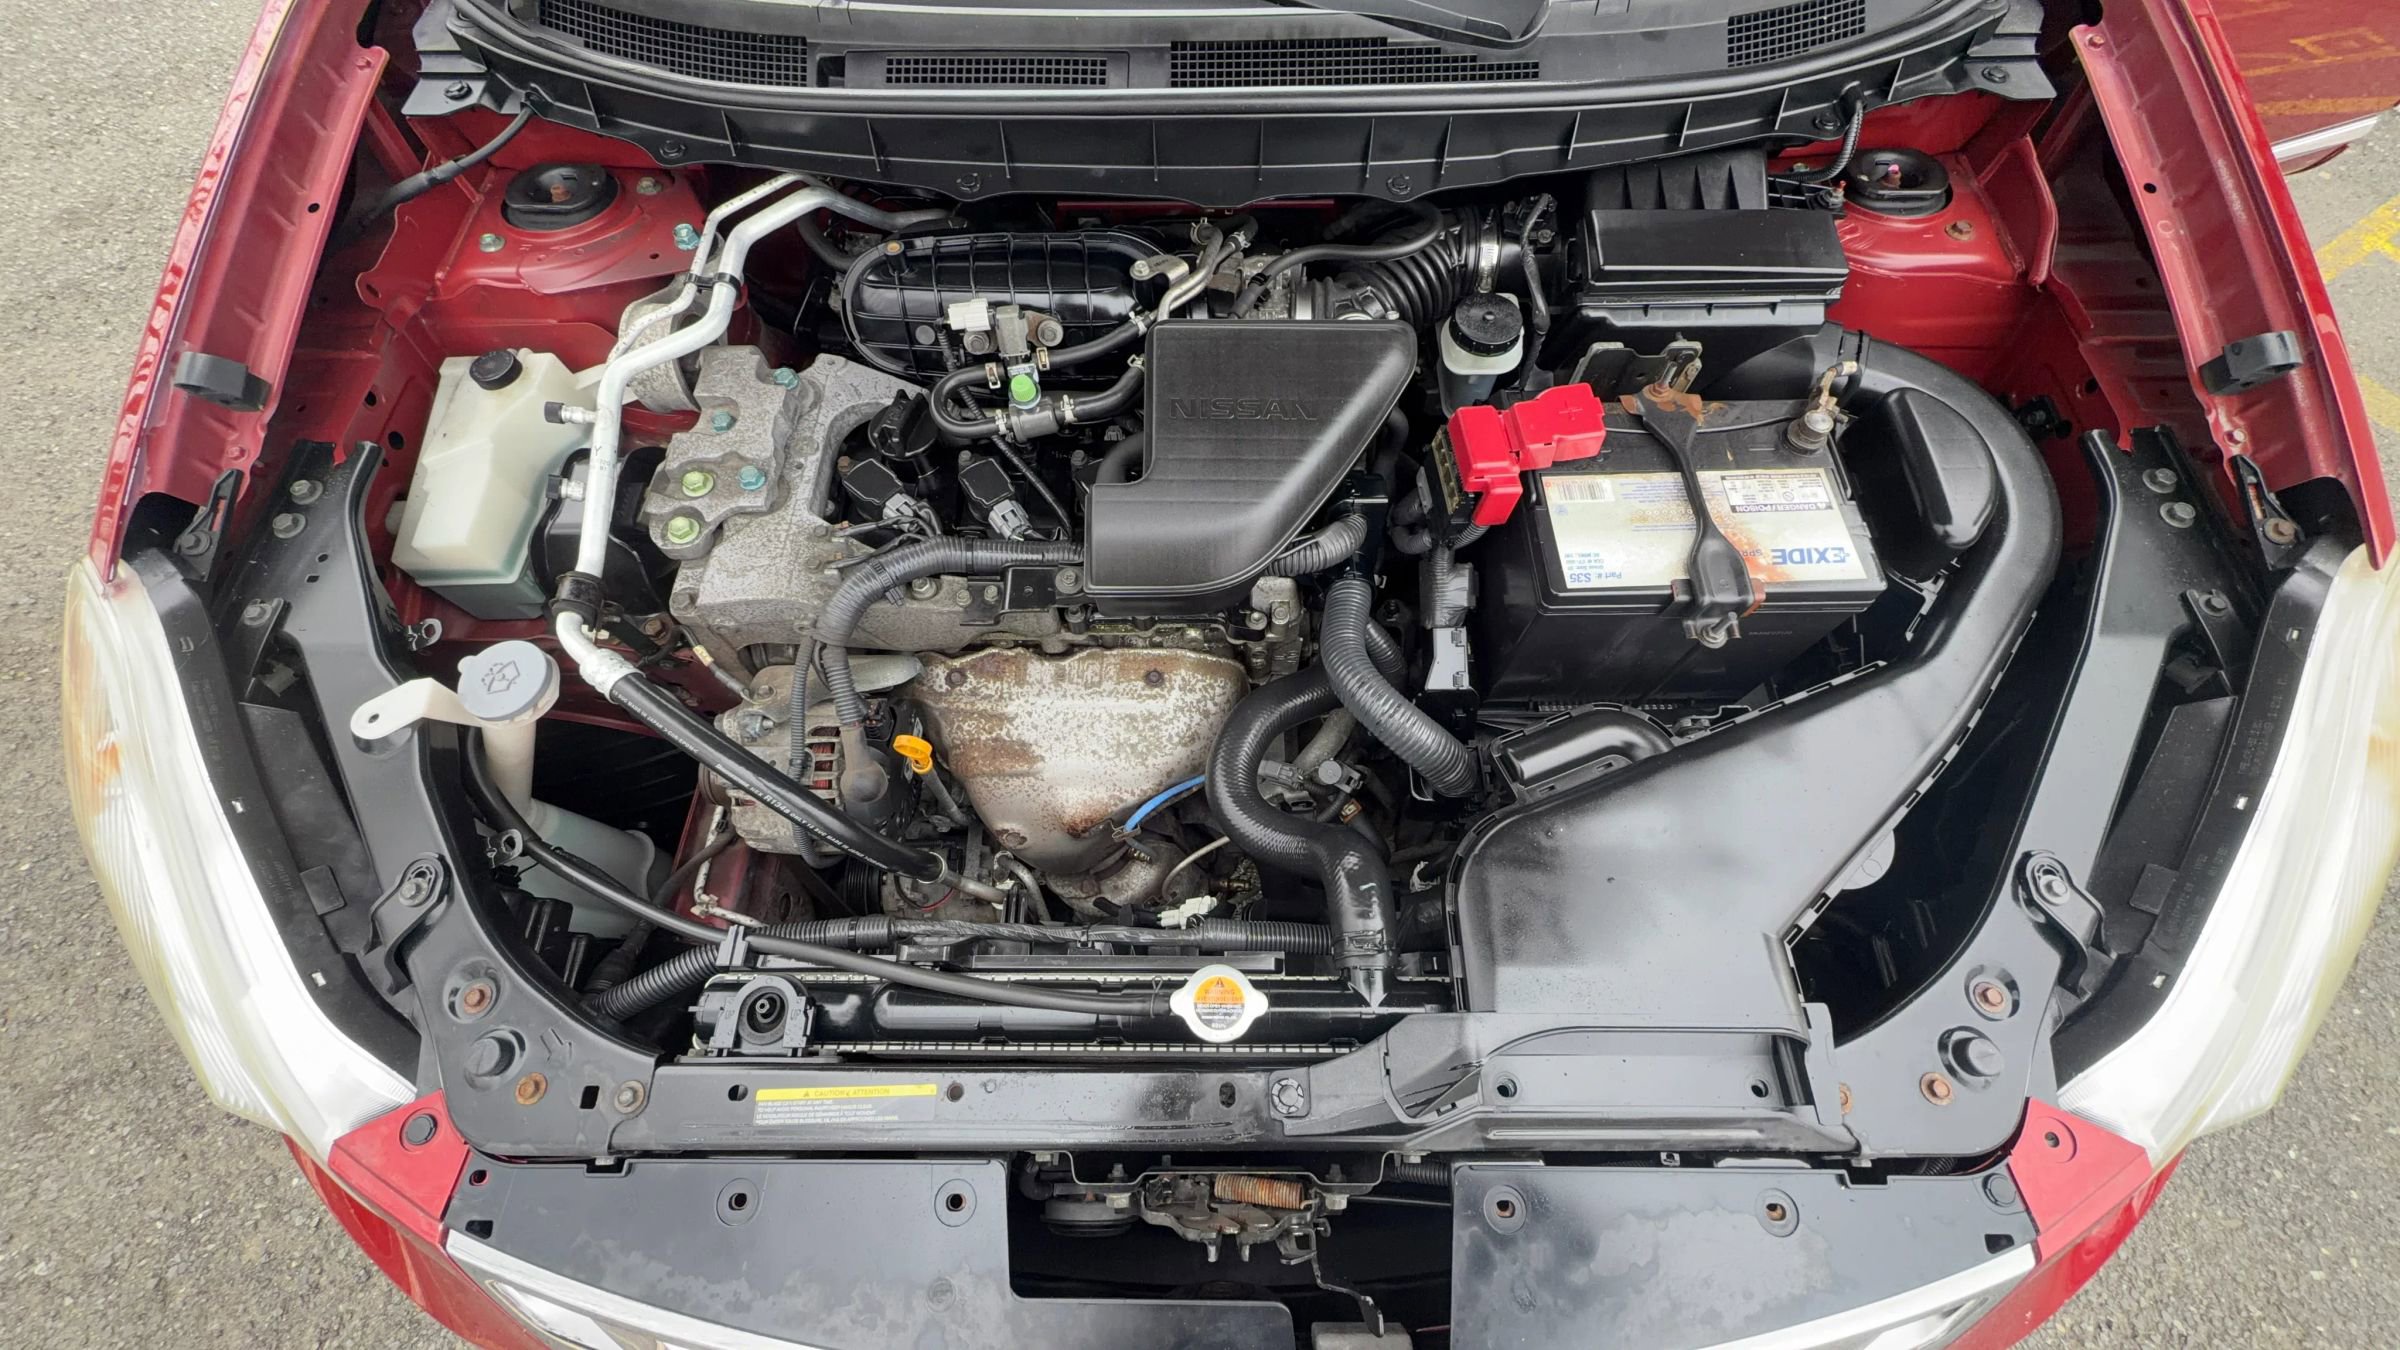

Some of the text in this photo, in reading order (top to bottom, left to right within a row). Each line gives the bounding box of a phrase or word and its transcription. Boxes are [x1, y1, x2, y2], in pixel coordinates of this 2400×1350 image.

[1168, 397, 1318, 420] NISSAN
[1735, 504, 1771, 512] POISON
[1778, 503, 1817, 511] DANGER
[1771, 547, 1850, 565] EXIDE
[1569, 573, 1592, 583] S35
[647, 715, 663, 729] JAPAN
[814, 1089, 845, 1097] CAUTION
[852, 1088, 890, 1096] ATTENTION
